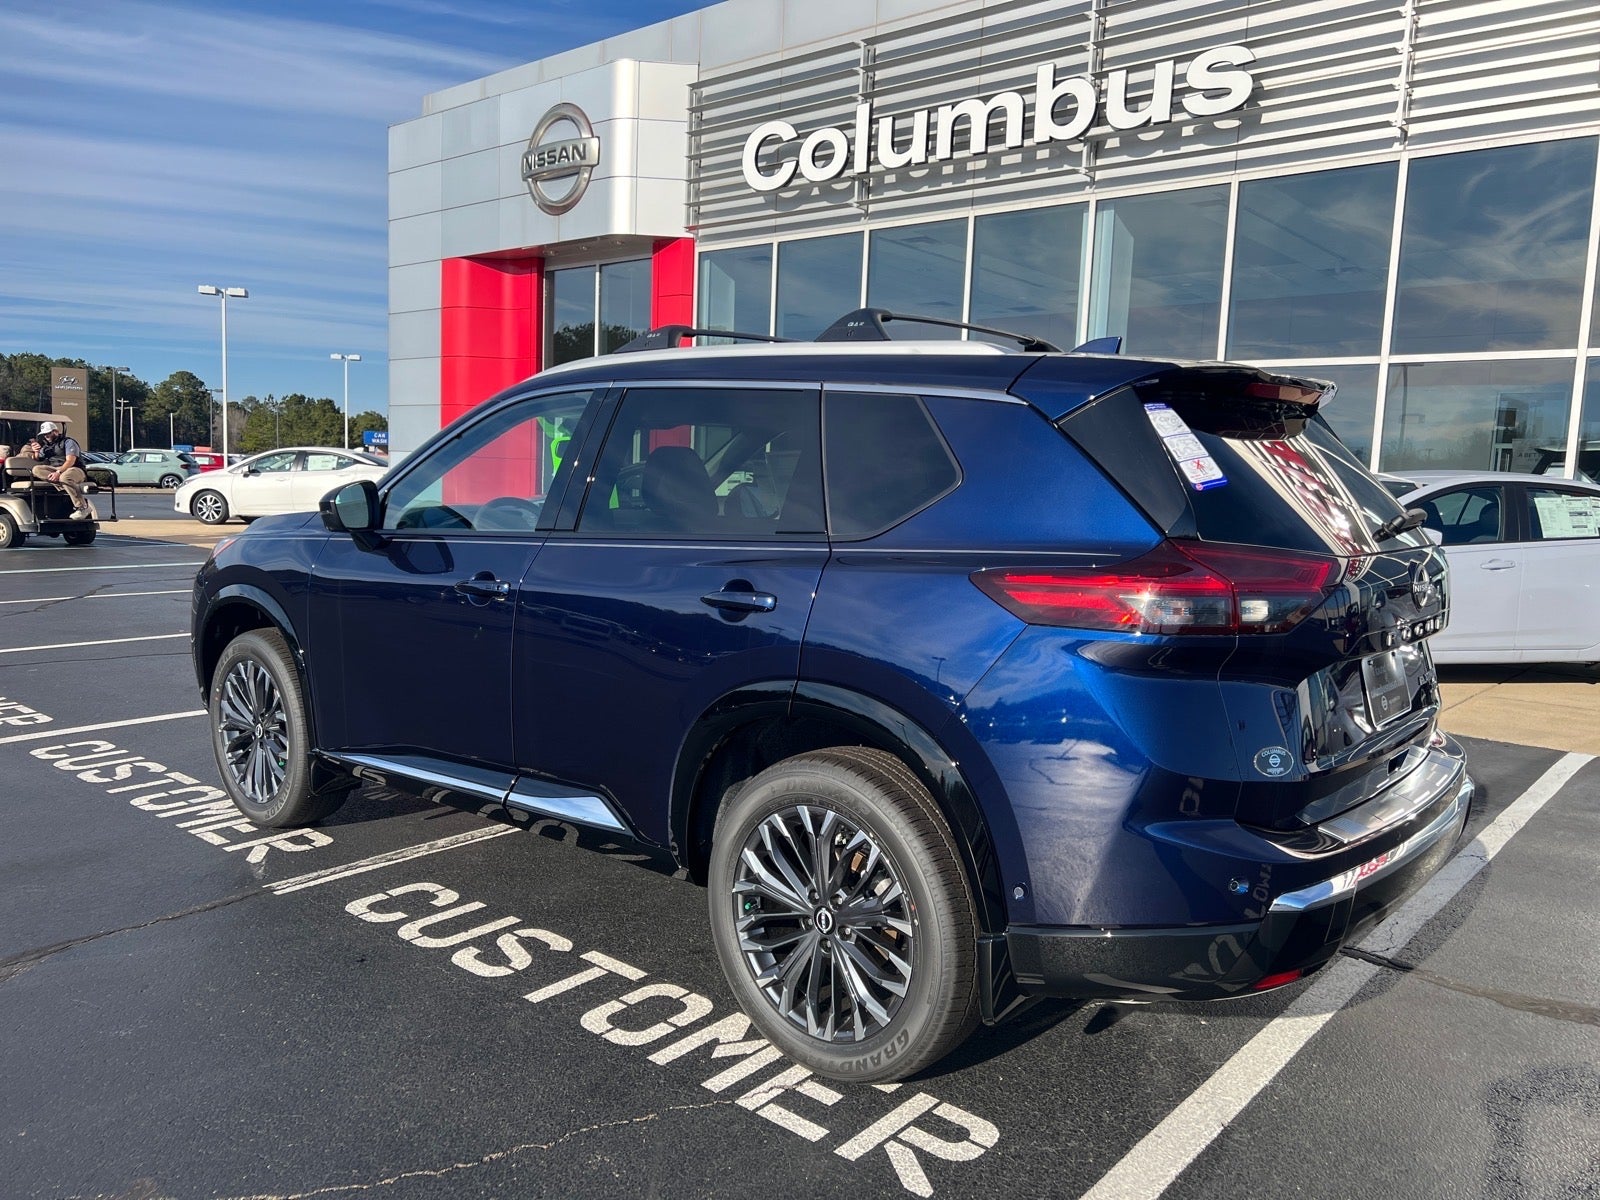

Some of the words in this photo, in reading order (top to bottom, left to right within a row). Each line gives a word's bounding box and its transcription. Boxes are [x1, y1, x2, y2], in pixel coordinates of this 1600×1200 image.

[523, 142, 587, 173] NISSAN
[741, 45, 1257, 192] Columbus
[29, 740, 334, 864] CUSTOMER
[344, 881, 1000, 1198] CUSTOMER
